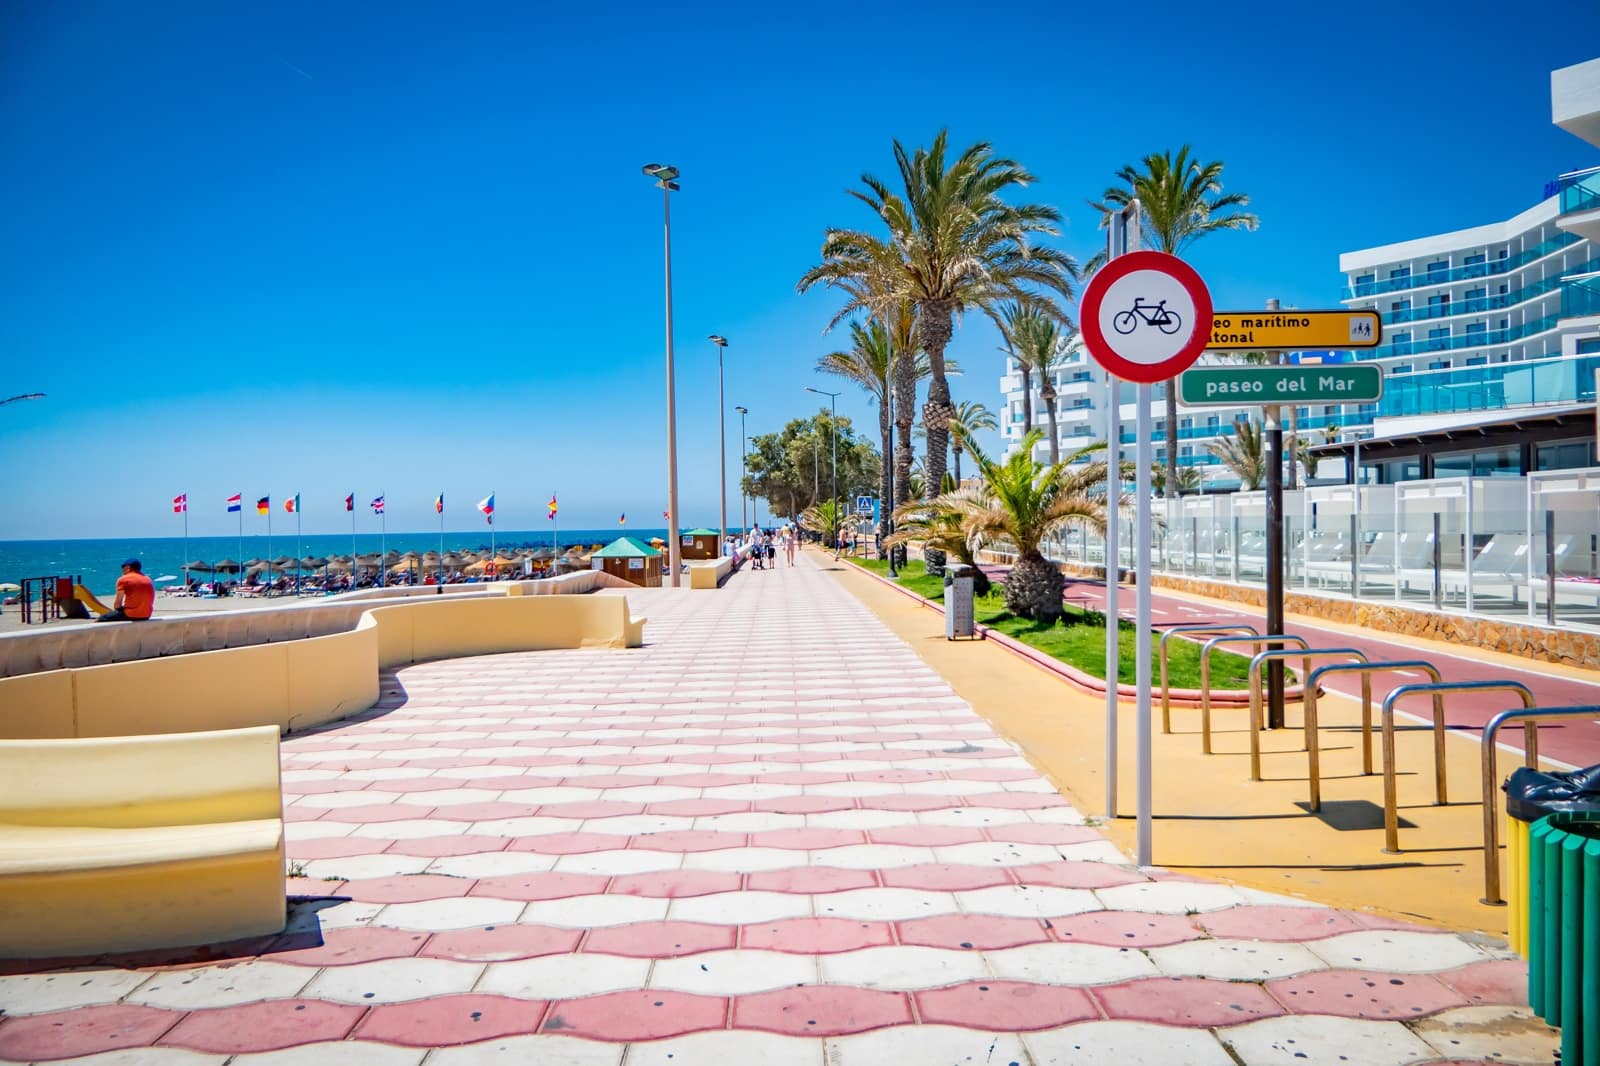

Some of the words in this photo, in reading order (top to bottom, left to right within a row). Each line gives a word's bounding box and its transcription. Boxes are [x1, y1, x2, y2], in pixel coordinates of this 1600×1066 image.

[1213, 319, 1231, 328] eo
[1208, 331, 1254, 343] tonal
[1206, 380, 1264, 397] paseo
[1276, 377, 1306, 392] del
[1318, 376, 1355, 391] Mar
